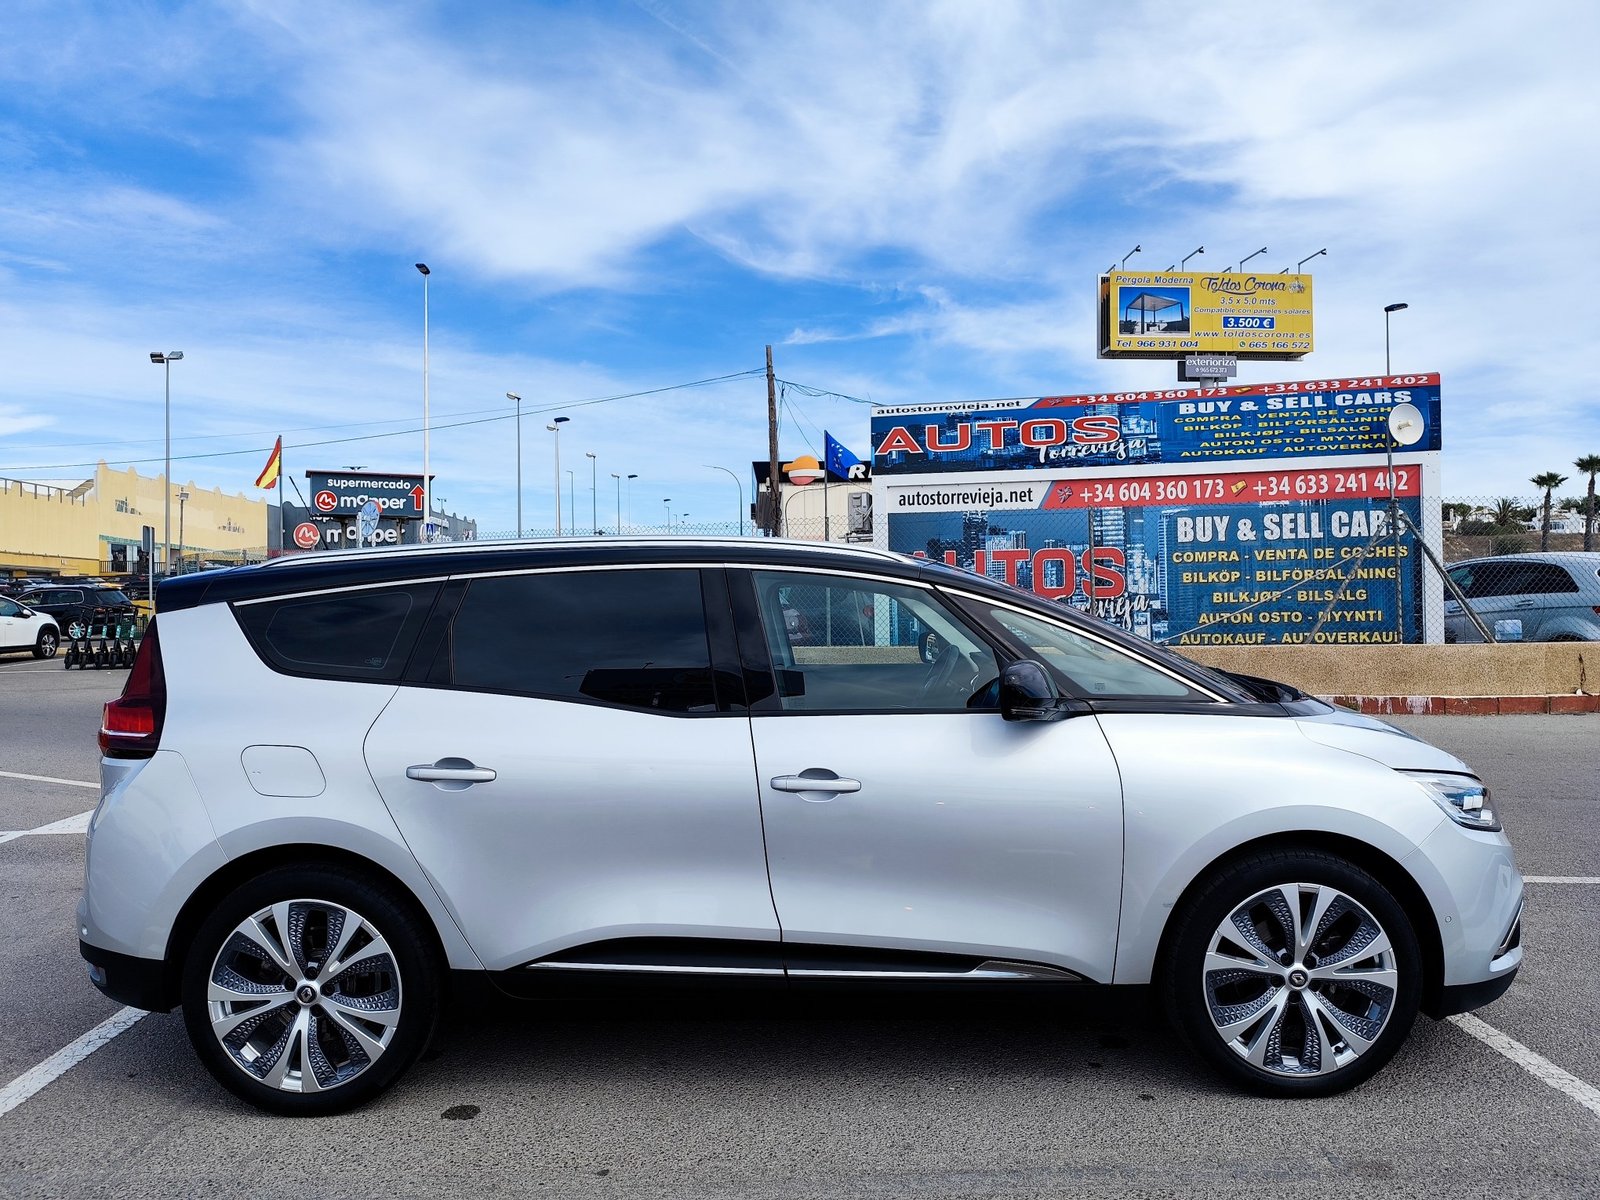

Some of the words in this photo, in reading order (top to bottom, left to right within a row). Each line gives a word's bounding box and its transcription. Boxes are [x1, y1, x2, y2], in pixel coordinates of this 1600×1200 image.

[1115, 275, 1151, 285] Pergola
[1154, 276, 1194, 284] Moderna
[1200, 277, 1241, 293] Toldos
[1244, 277, 1287, 291] Corona
[1220, 297, 1234, 305] 3,5
[1244, 297, 1257, 305] 5,0
[1227, 318, 1260, 328] 3.500
[1263, 318, 1272, 328] €
[1137, 340, 1156, 348] 966
[1249, 341, 1268, 349] 665
[1271, 341, 1289, 349] 166
[1186, 357, 1236, 366] exterioriza
[1258, 383, 1299, 394] +34
[1305, 381, 1341, 391] 633
[1347, 378, 1382, 388] 241
[1391, 376, 1429, 386] 402
[1072, 394, 1109, 404] +34
[1114, 393, 1147, 402] 604
[1153, 390, 1188, 400] 360
[1195, 388, 1228, 397] 173
[1179, 401, 1232, 415] BUY
[1240, 400, 1259, 411] &
[1266, 396, 1327, 410] SELL
[1335, 391, 1412, 406] CARS
[877, 400, 1022, 415] autostorrevieja.net
[1174, 415, 1241, 424] COMPRA
[1257, 411, 1311, 419] VENTA
[1344, 406, 1393, 415] COCH
[1183, 423, 1242, 432] BILKÖP
[1258, 416, 1388, 428] BILFÖRSÄLJNIN
[875, 416, 1120, 455] AUTOS
[1214, 430, 1284, 439] BILKJØP
[1300, 425, 1371, 435] BILSALG
[1200, 440, 1255, 448] AUTON
[1261, 437, 1305, 445] OSTO
[1320, 433, 1386, 442] MYYNTI
[1033, 436, 1146, 464] Torrevieja
[1180, 447, 1268, 458] AUTOKAUF
[327, 478, 411, 490] supermercado
[1079, 482, 1116, 503] +34
[1119, 481, 1151, 502] 604
[1155, 480, 1188, 500] 360
[1193, 479, 1225, 499] 173
[1253, 476, 1291, 497] +34
[1295, 474, 1329, 495] 633
[1334, 472, 1367, 493] 241
[1374, 471, 1408, 490] 402
[898, 487, 1034, 510] autostorrevieja.net
[1177, 515, 1230, 543] BUY
[1237, 518, 1256, 541] &
[1263, 512, 1323, 542] SELL
[326, 525, 406, 547] mape
[1172, 551, 1240, 563] COMPRA
[1254, 548, 1309, 560] VENTA
[1313, 547, 1335, 559] DE
[912, 547, 1126, 599] TOS
[1182, 569, 1241, 583] BILKÖP
[1213, 590, 1281, 603] BILKJØP
[1297, 589, 1368, 602] BILSALG
[1199, 612, 1253, 624] AUTON
[1259, 611, 1303, 623] OSTO
[1180, 632, 1266, 644] AUTOKAUF
